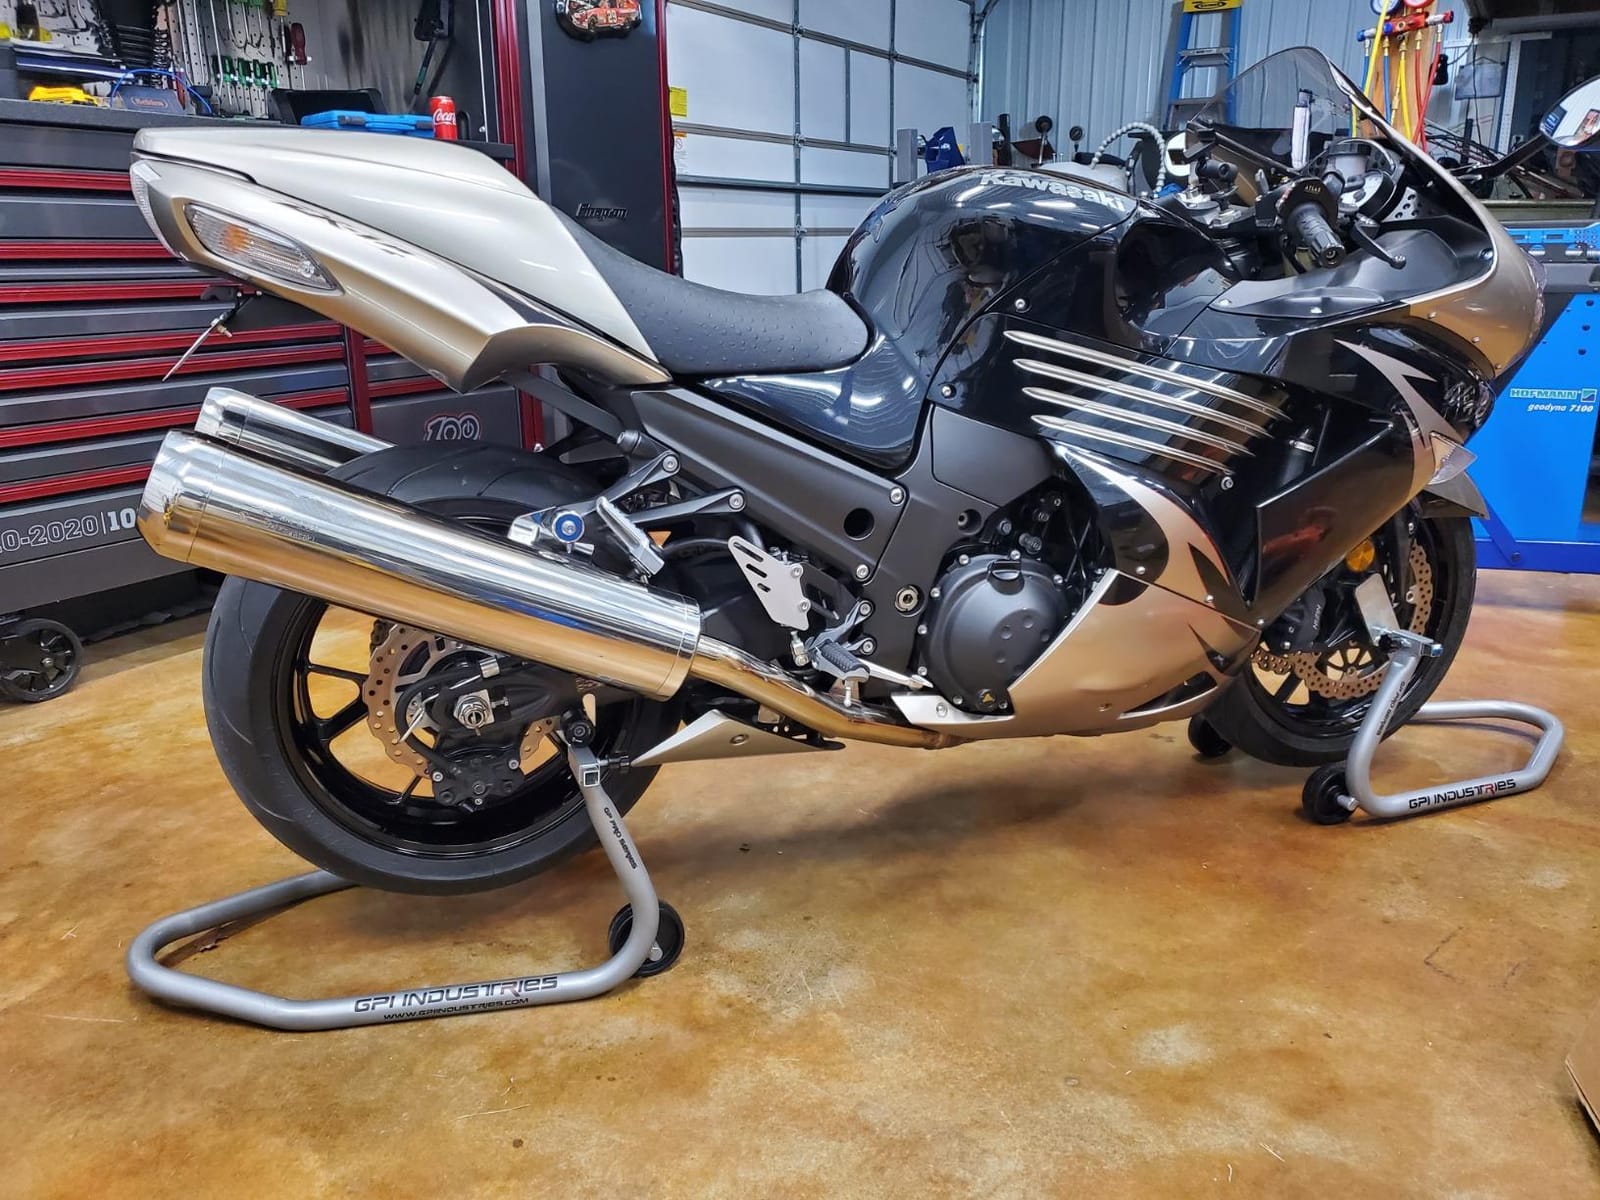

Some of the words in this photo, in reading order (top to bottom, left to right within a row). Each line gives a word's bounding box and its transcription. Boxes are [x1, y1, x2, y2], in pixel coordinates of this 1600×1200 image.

[979, 173, 1126, 212] Kawasaki
[1510, 388, 1578, 400] HOFMANN
[1528, 403, 1567, 412] geodyna
[1569, 404, 1594, 413] 7100
[1408, 795, 1431, 809] GPI
[354, 995, 396, 1013] GPI
